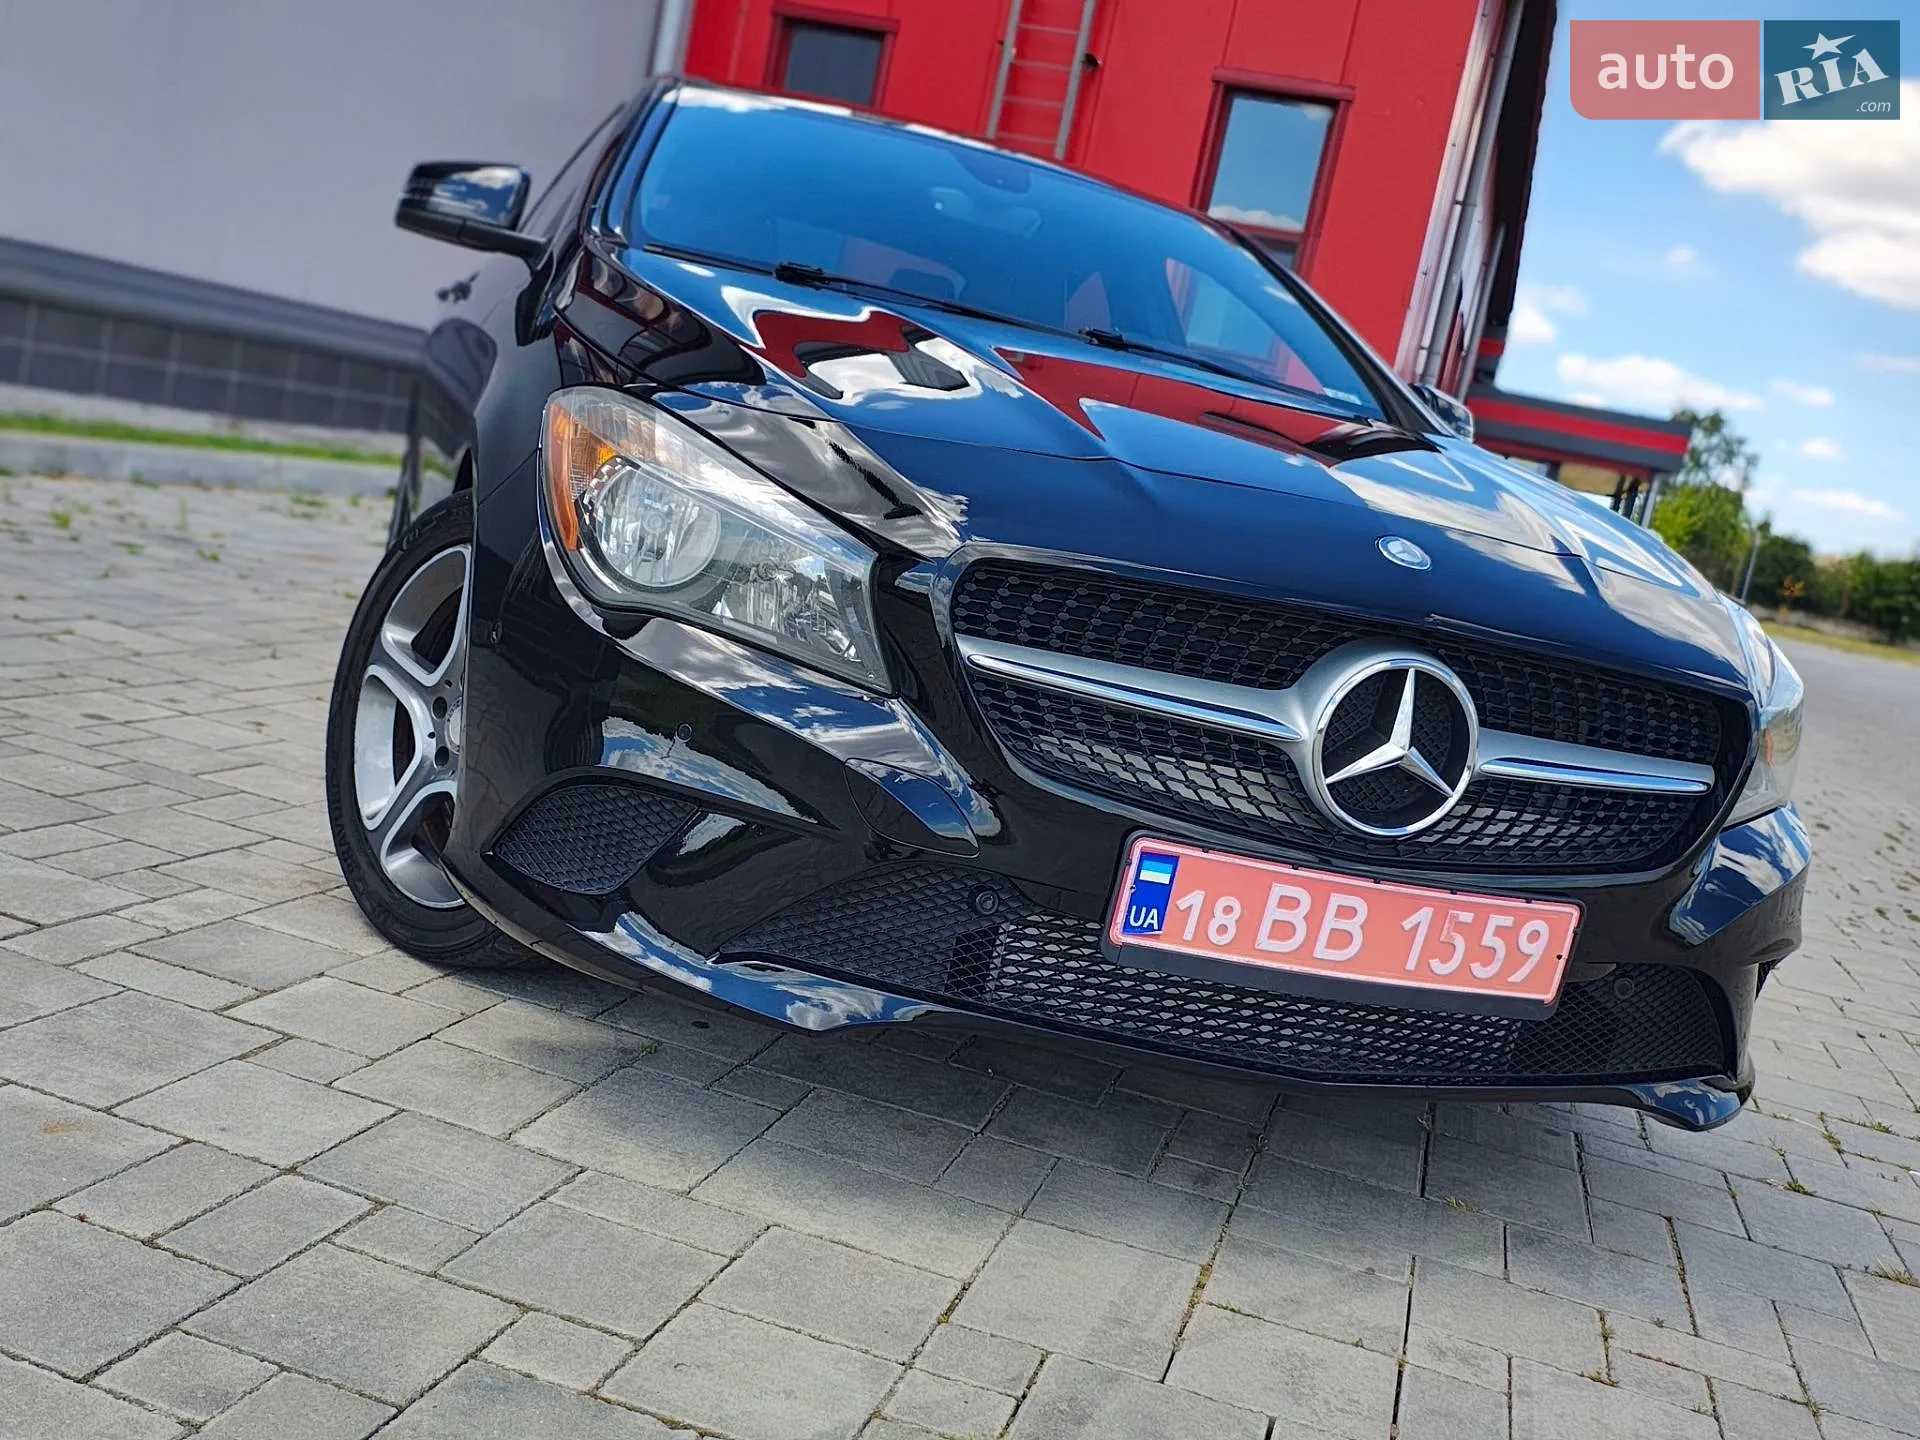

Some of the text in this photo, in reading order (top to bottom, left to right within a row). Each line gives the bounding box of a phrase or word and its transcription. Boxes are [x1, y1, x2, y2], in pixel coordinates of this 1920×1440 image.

[1129, 905, 1160, 931] UA
[1176, 883, 1550, 983] 18 BB 1559
